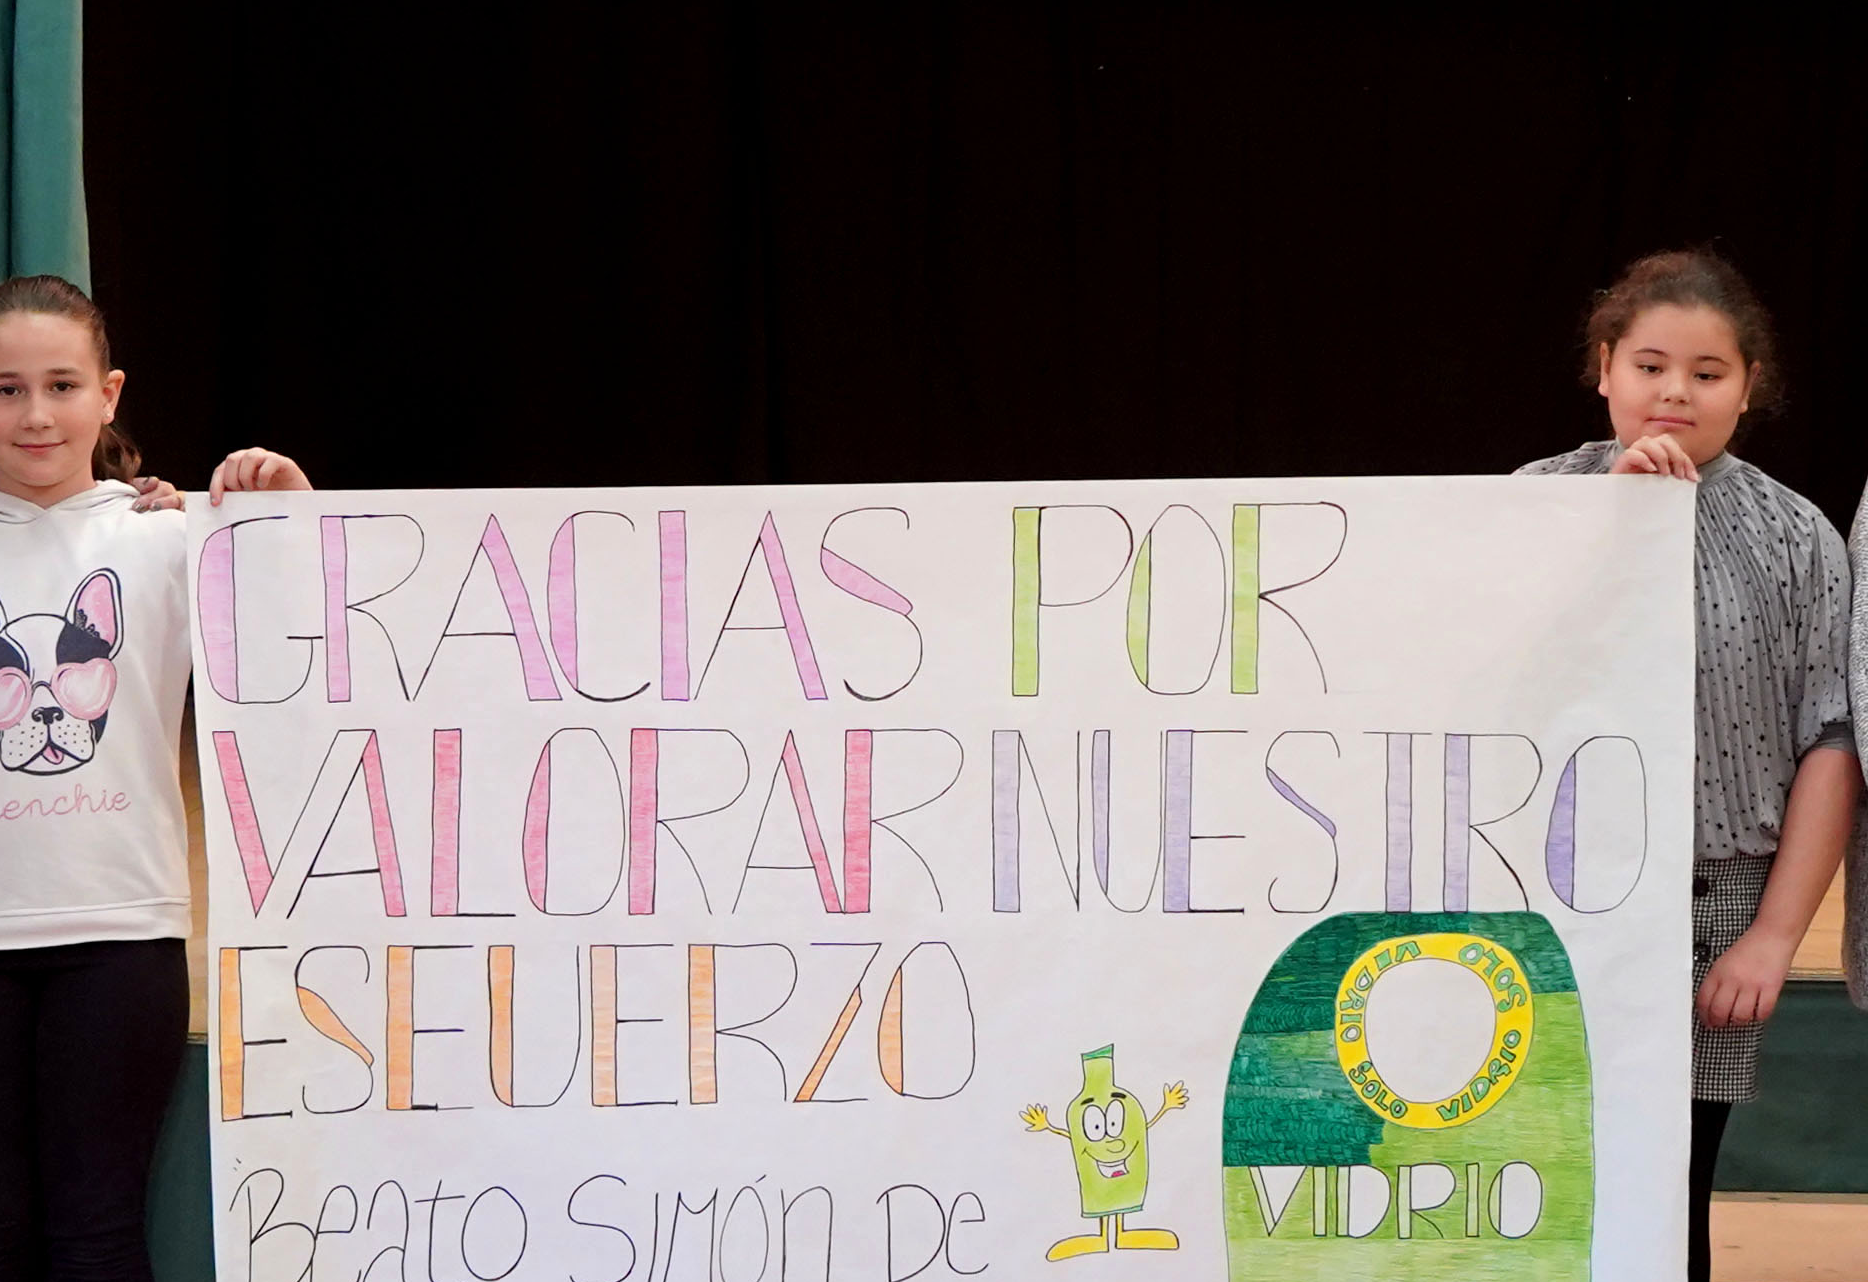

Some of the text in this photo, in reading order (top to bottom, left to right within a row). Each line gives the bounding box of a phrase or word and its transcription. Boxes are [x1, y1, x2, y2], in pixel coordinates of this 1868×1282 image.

[197, 502, 1348, 705] GRACIAS POR
[212, 728, 1648, 920] VALORAR NUESTRO
[1340, 940, 1422, 1043] VIDRIO
[1458, 942, 1527, 1013] SOLO
[1349, 1060, 1408, 1119] SOLO
[1436, 1029, 1522, 1122] VIDRIO
[1249, 1160, 1544, 1240] VIDRIO
